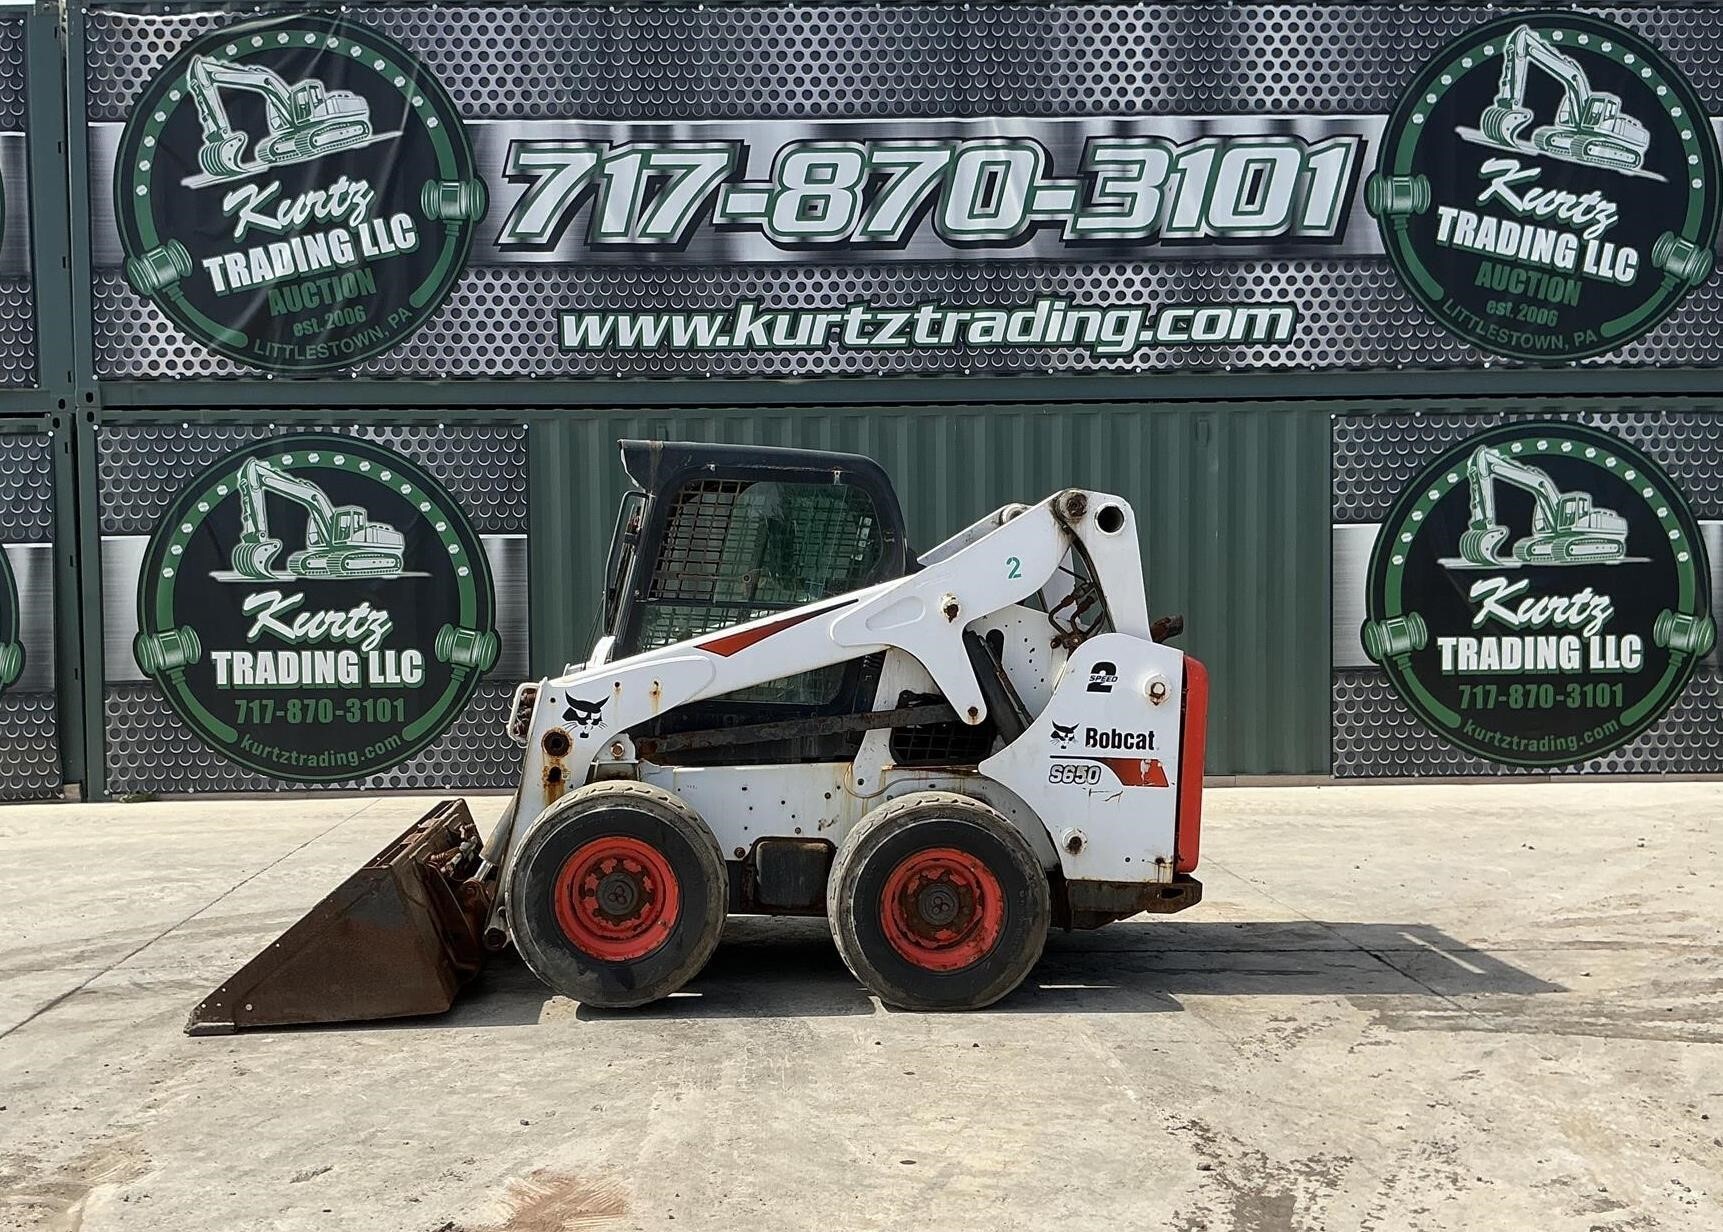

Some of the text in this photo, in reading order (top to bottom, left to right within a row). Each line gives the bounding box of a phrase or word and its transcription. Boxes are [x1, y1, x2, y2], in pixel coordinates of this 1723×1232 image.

[223, 176, 374, 238] Kurtz
[498, 137, 1359, 251] 717-870-3101
[1478, 158, 1618, 239] Kurtz
[203, 213, 417, 293] TRADING LLC
[1436, 206, 1639, 283] TRADING LLC
[268, 268, 377, 317] AUCTION
[1474, 261, 1582, 307] AUCTION
[253, 307, 413, 360] LITTLESTOWN, PA
[293, 305, 367, 338] est. 2006
[558, 298, 1296, 357] www.kurtztrading.com
[1443, 299, 1598, 350] LITTLESTOWN, PA
[1486, 299, 1558, 327] est. 2006
[1006, 557, 1022, 579] 2
[243, 591, 392, 651] Kurtz
[1470, 577, 1614, 637] Kurtz
[211, 649, 424, 687] TRADING LLC
[1437, 634, 1643, 673] TRADING LLC
[1087, 662, 1117, 693] 2
[1459, 683, 1623, 709] 717-870-3101
[235, 698, 406, 724] 717-870-3101
[240, 734, 401, 768] kurtztrading.com
[1085, 728, 1155, 750] Bobcat
[1464, 720, 1618, 752] kurtztrading.com
[1049, 765, 1101, 785] S650
